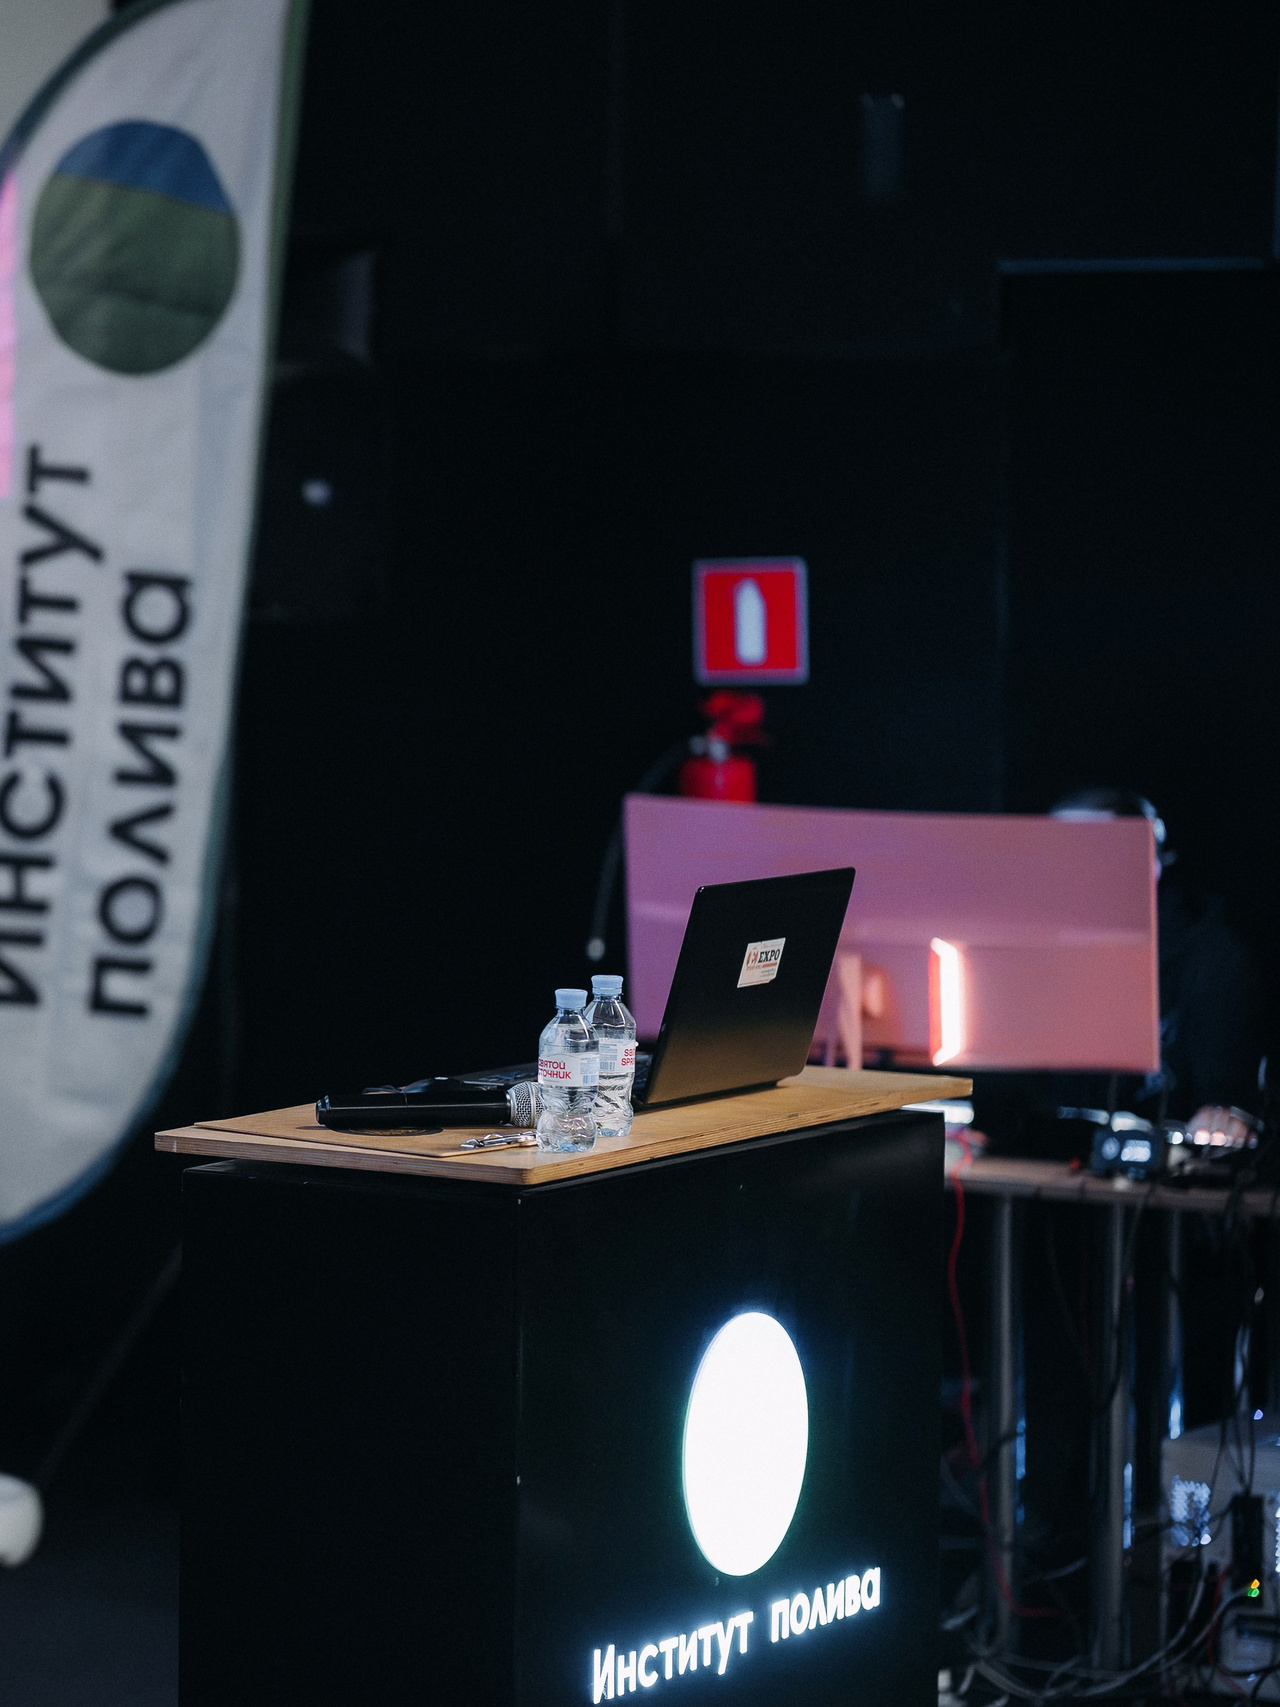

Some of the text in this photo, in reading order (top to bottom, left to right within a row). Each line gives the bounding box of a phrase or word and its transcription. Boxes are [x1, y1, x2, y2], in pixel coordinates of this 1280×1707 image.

[87, 568, 194, 1021] полива
[758, 948, 781, 963] EXPO
[592, 1566, 881, 1705] Институт полива
